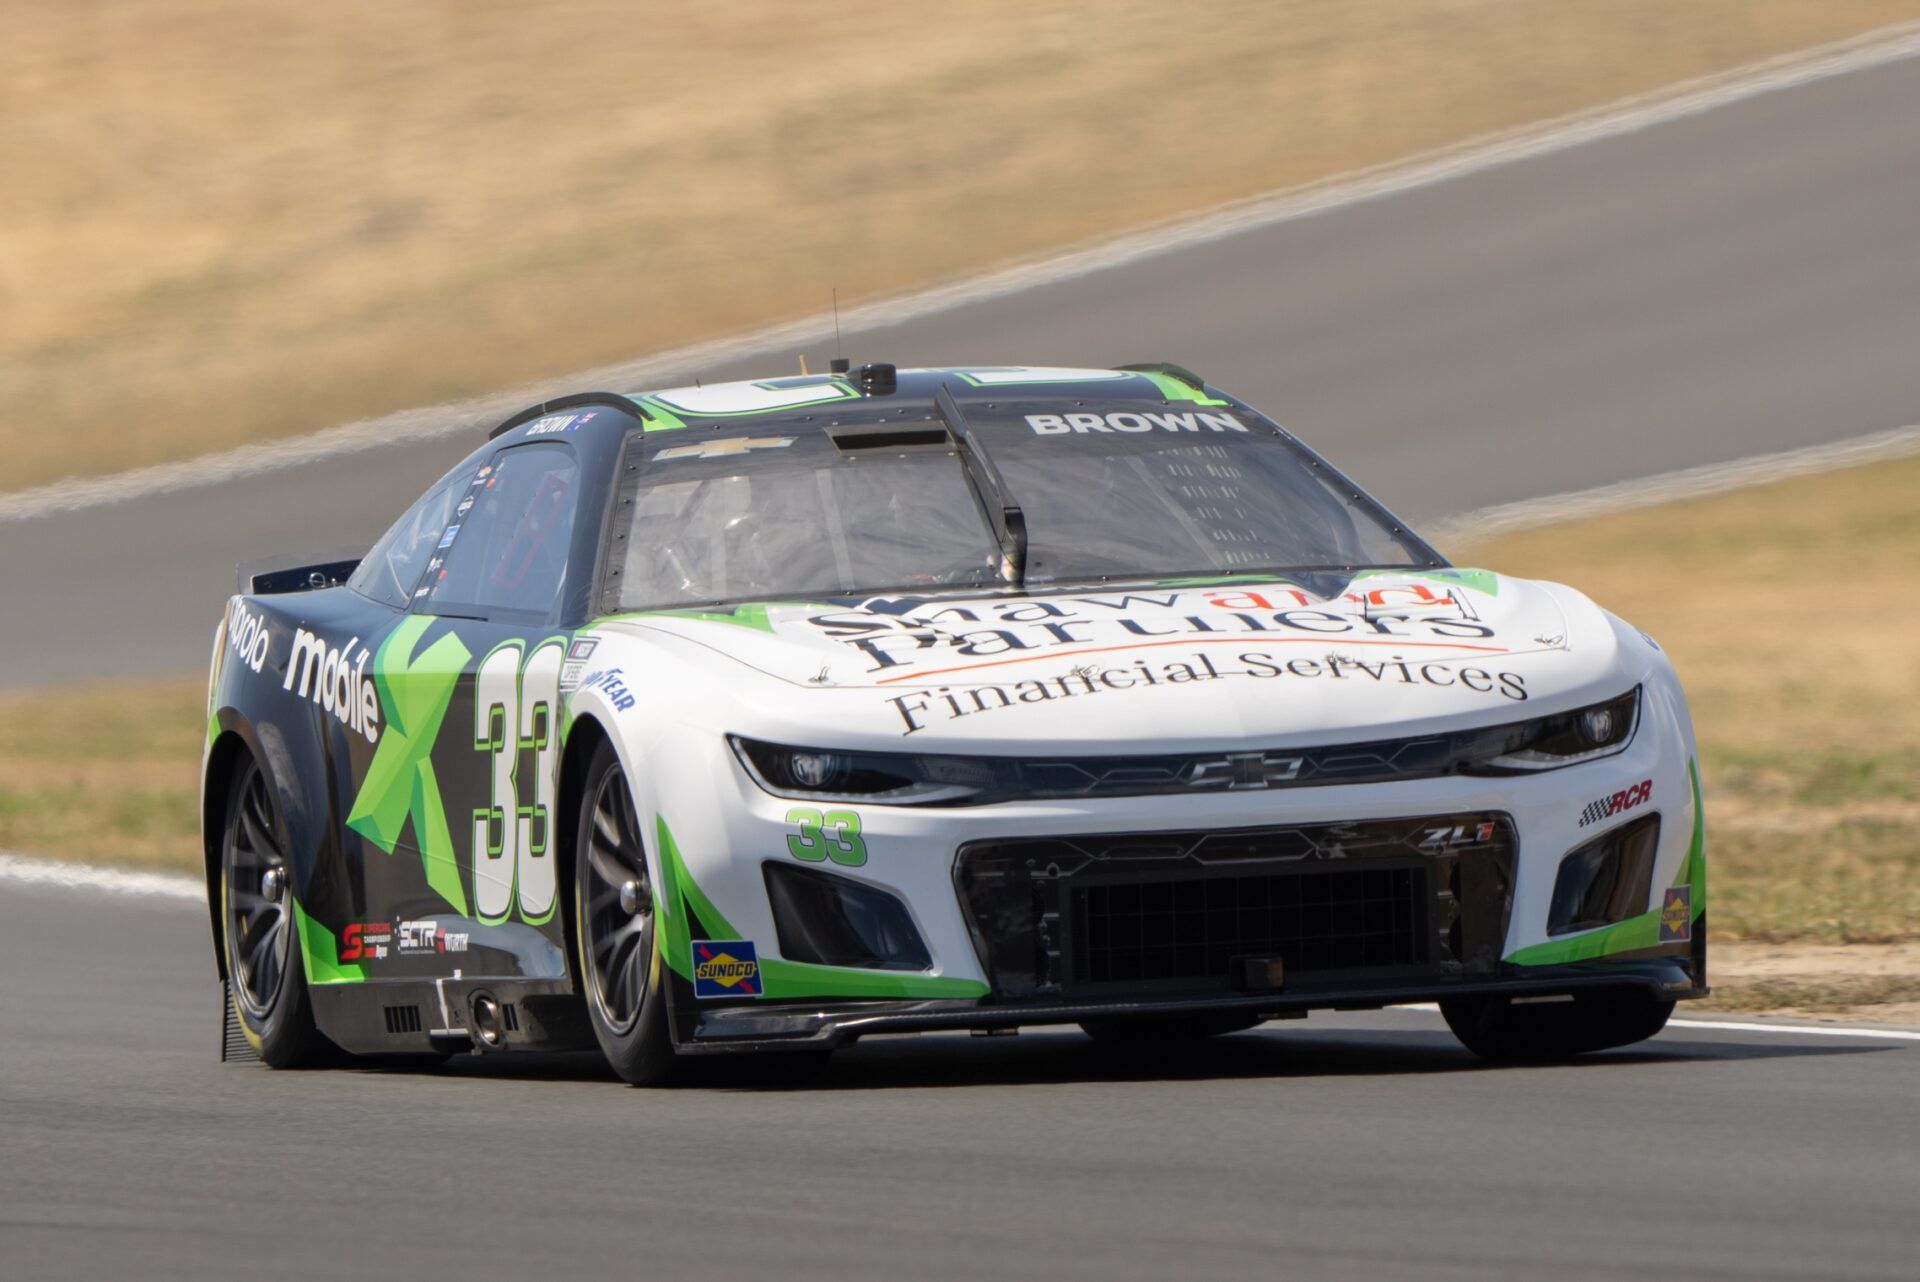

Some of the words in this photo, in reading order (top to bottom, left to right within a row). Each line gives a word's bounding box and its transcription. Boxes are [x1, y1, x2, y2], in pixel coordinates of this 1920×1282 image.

[1025, 412, 1249, 435] BROWN
[885, 652, 1225, 736] Financial
[1238, 653, 1528, 701] Services
[473, 635, 568, 926] 33
[785, 806, 868, 868] 33
[698, 961, 755, 979] SUNOCO
